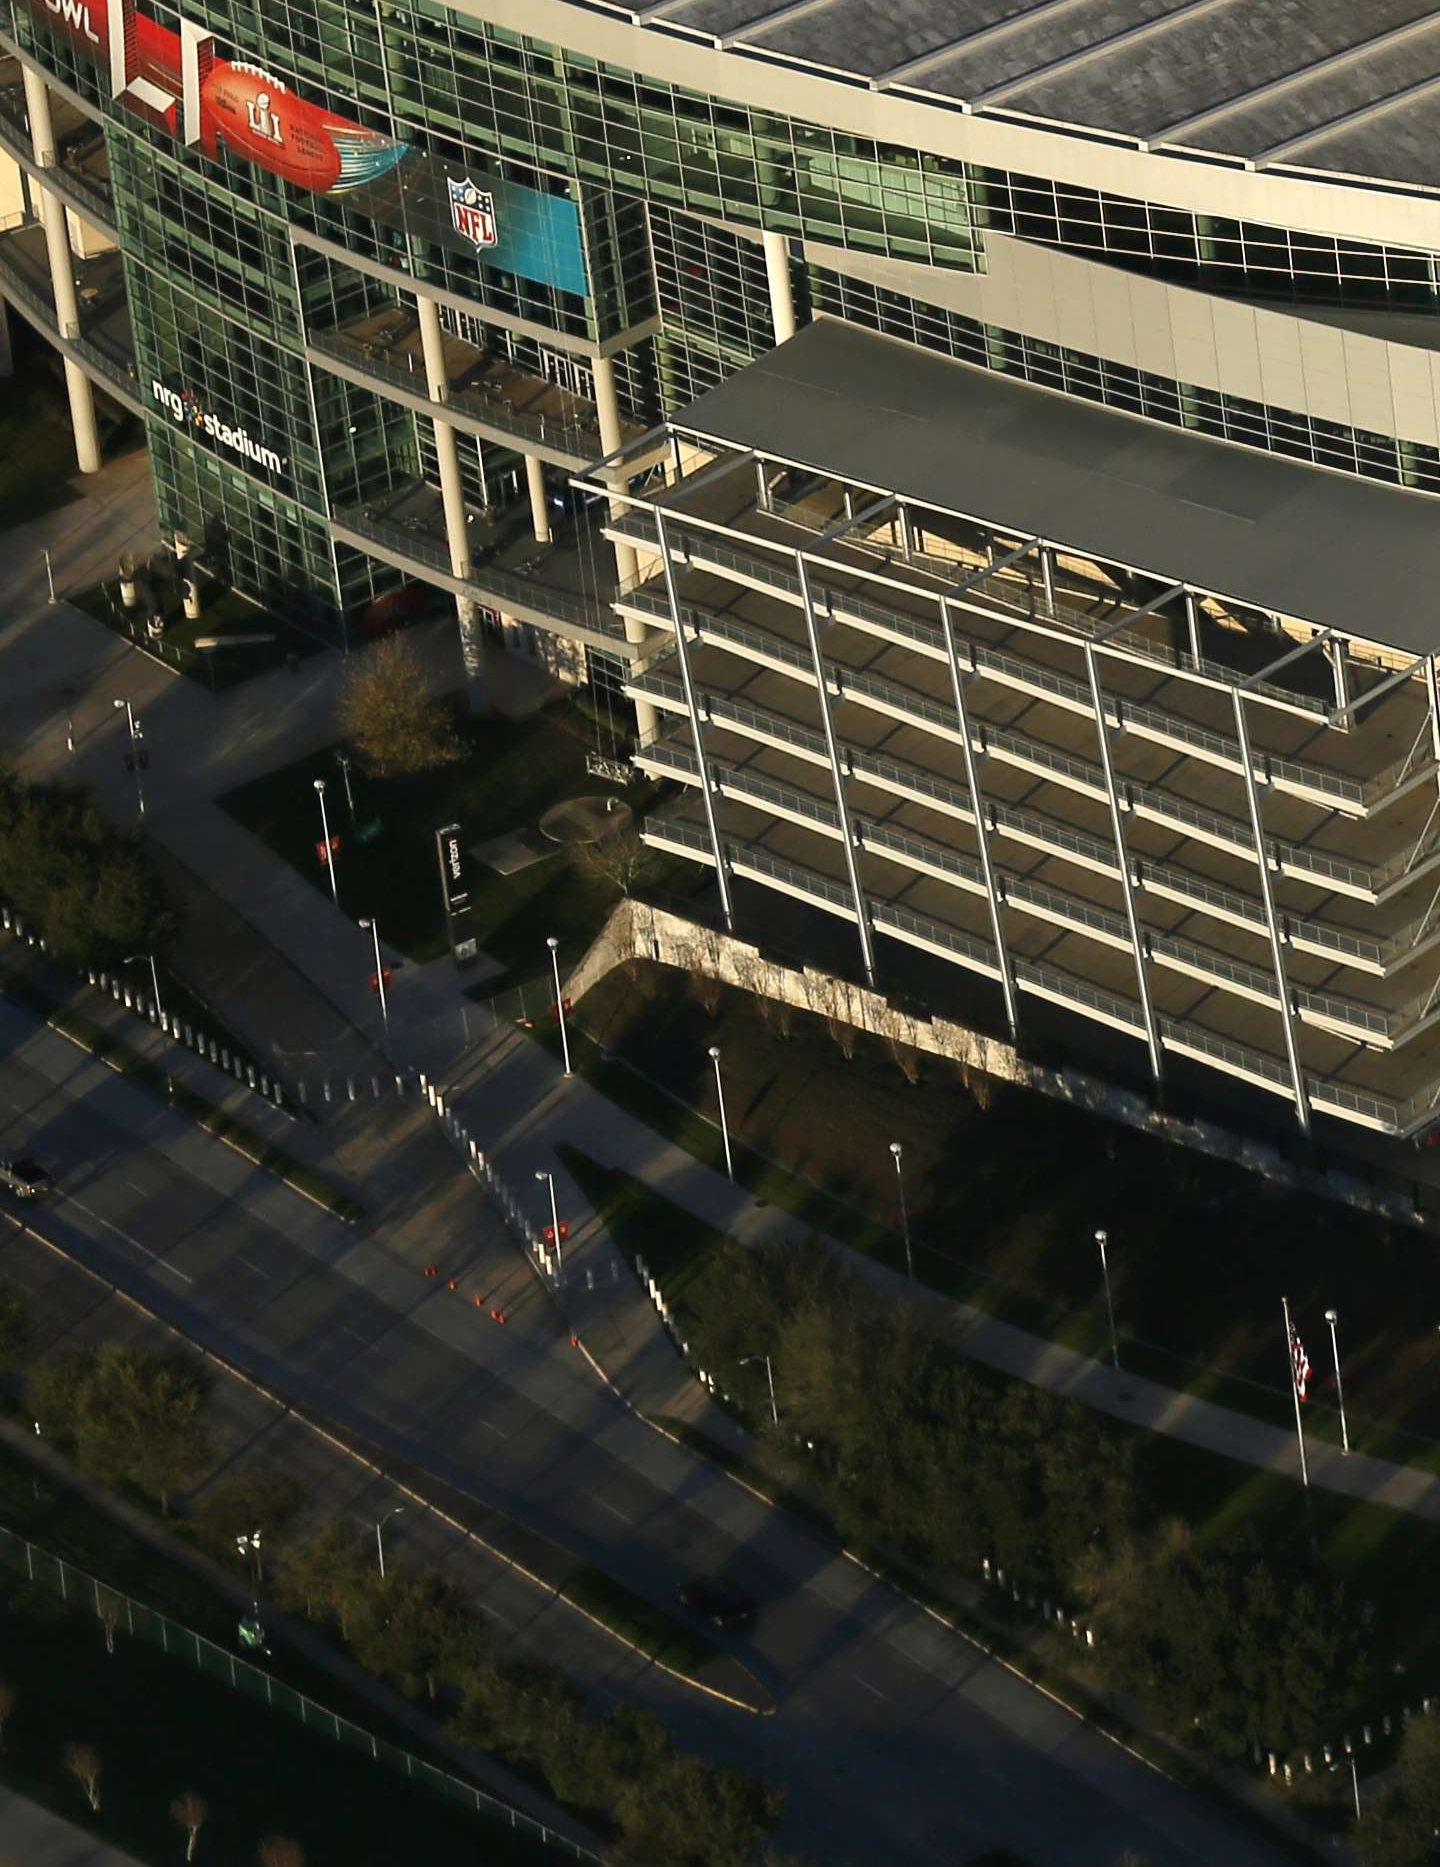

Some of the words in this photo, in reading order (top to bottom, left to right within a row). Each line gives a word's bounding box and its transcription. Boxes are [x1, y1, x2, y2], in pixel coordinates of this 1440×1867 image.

[455, 205, 493, 242] NFL
[151, 380, 184, 422] nrg
[203, 414, 282, 474] stadium
[448, 838, 462, 880] verizon
